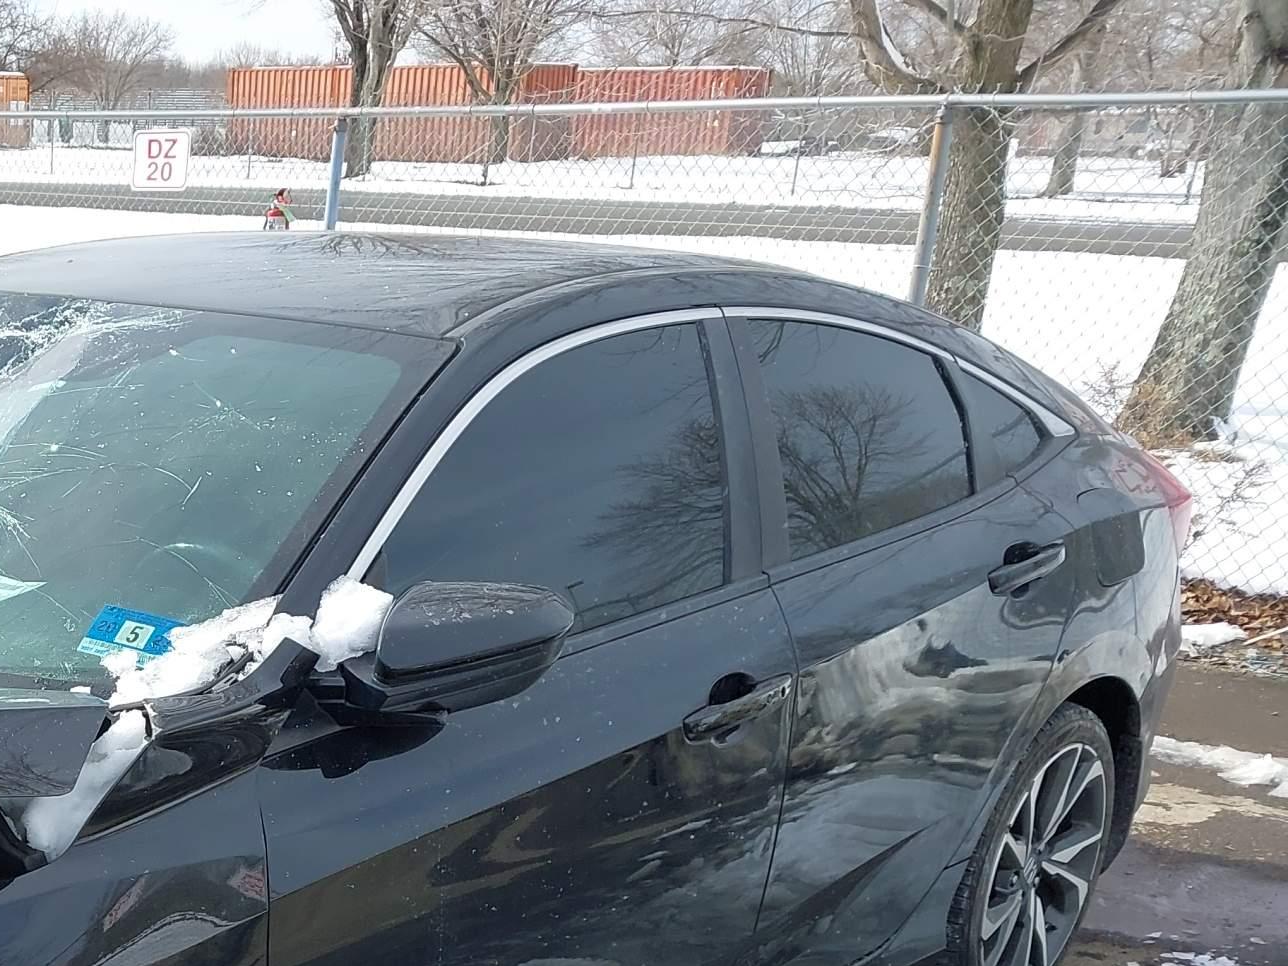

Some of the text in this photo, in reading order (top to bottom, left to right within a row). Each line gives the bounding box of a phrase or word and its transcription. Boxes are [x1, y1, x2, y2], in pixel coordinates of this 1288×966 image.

[147, 138, 178, 159] DZ
[146, 161, 173, 182] 20
[125, 625, 144, 643] 5
